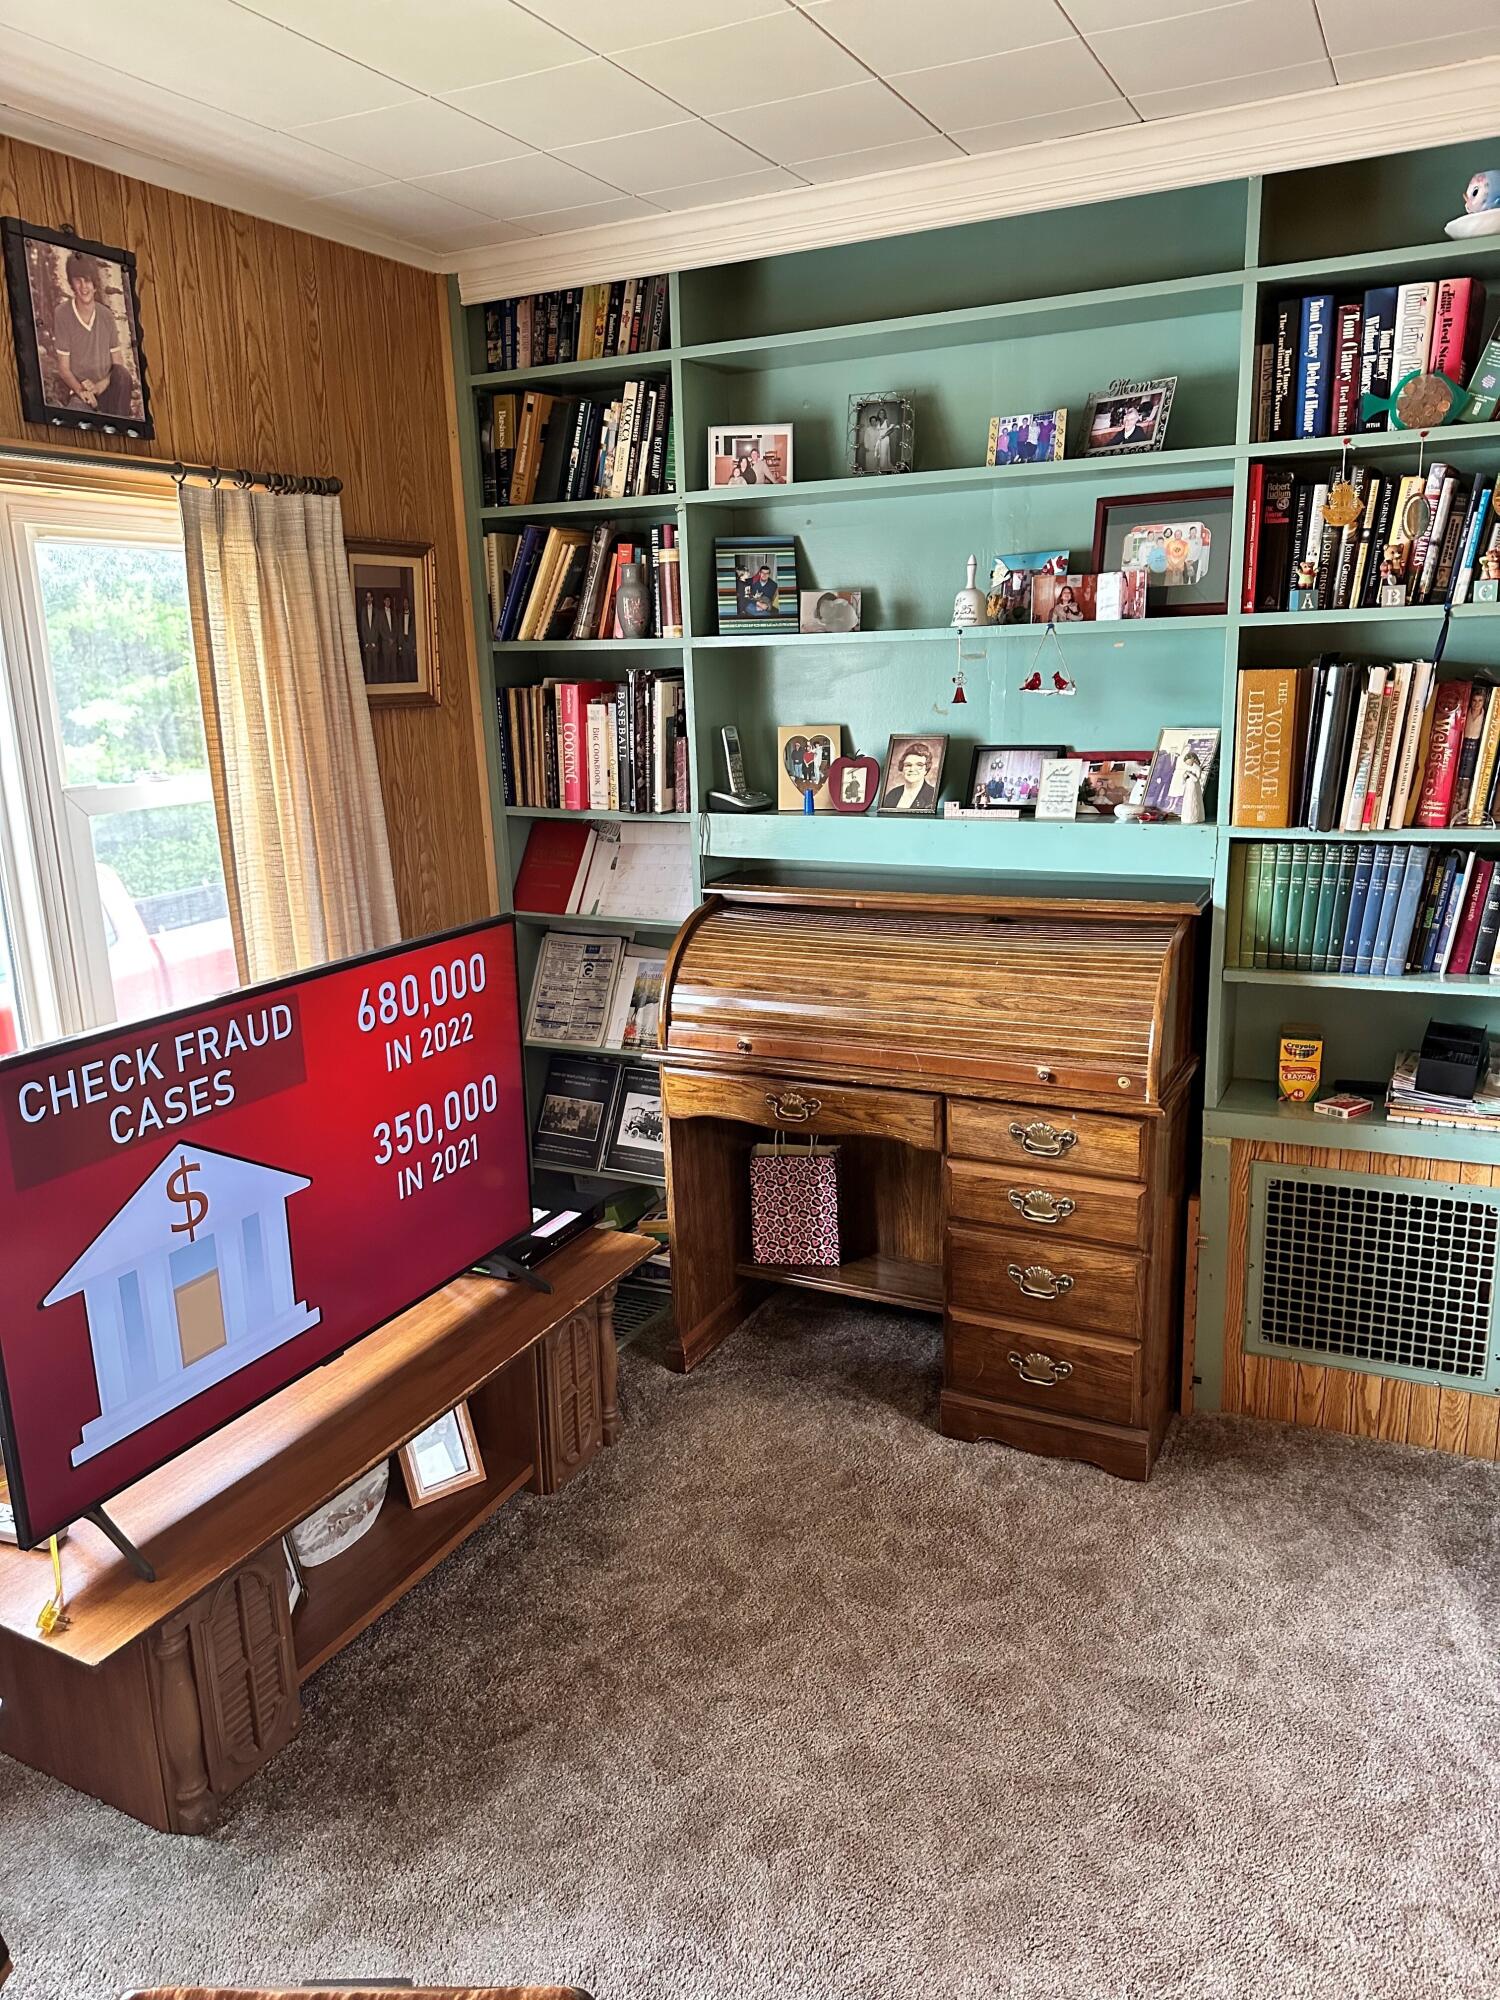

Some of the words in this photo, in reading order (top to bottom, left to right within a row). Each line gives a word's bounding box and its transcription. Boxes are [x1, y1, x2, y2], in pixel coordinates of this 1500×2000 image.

[1309, 299, 1324, 322] Tom
[1405, 286, 1429, 313] Tom
[1438, 283, 1450, 317] Clancy
[1445, 290, 1455, 312] Tom
[1279, 313, 1287, 330] The
[1342, 312, 1360, 339] Tom
[1363, 316, 1379, 353] Without
[1397, 314, 1426, 355] Clancy
[1441, 318, 1453, 344] Red
[1276, 332, 1286, 369] Cardinal
[1303, 324, 1322, 358] Clancy
[1380, 329, 1393, 348] Tom
[1283, 348, 1292, 367] Tom
[1337, 342, 1357, 382] Clancy
[1376, 349, 1392, 380] Clancy
[1399, 359, 1422, 379] Ra
[1437, 346, 1448, 373] Stor
[1109, 379, 1151, 396] Mom
[1276, 370, 1284, 378] of
[1282, 368, 1291, 396] Clancy
[1305, 362, 1321, 387] Debt
[1360, 355, 1377, 395] Remorse
[636, 381, 644, 414] UNFINISHED
[1305, 388, 1319, 399] of
[1339, 386, 1349, 403] Red
[498, 411, 506, 448] Business
[622, 398, 634, 442] IACOCCA
[656, 401, 665, 431] FEINSTEIN
[1303, 401, 1318, 433] Honor
[1337, 406, 1347, 434] Rabbit
[654, 437, 662, 453] NEXT
[652, 469, 658, 478] UP
[1356, 469, 1364, 482] THE
[1267, 490, 1290, 499] Ludlum
[1298, 493, 1306, 508] THE
[1383, 483, 1392, 502] JOHN
[1295, 510, 1305, 538] APPEAL
[1378, 502, 1389, 533] GRISHAM
[1294, 539, 1302, 559] JOHN
[1322, 539, 1332, 565] JOHN
[1344, 543, 1354, 562] JOHN
[1318, 567, 1330, 607] GRISHAM
[1338, 564, 1350, 596] GRISHAM
[1478, 584, 1493, 601] C
[1301, 595, 1315, 609] A
[1387, 589, 1400, 605] B
[1278, 679, 1288, 705] THE
[617, 692, 626, 761] BASEBALL
[1383, 690, 1401, 749] GRANDFATHER
[1244, 690, 1265, 780] LIBRARY
[563, 723, 578, 784] COOKING
[593, 743, 601, 785] COOKBOOK
[1261, 708, 1282, 799] VOLUME
[1354, 753, 1370, 799] NATURE
[1376, 749, 1392, 798] REMEMBERS
[357, 953, 487, 1032] 680,000
[385, 1040, 413, 1073] IN
[419, 1012, 474, 1060] 2022
[18, 1043, 165, 1124] CHECK
[176, 1003, 293, 1074] FRAUD
[1283, 1073, 1316, 1081] CRAYONS
[109, 1069, 235, 1144] CASES
[372, 1074, 499, 1165] 350,000
[397, 1168, 424, 1200] IN
[431, 1134, 480, 1183] 2021
